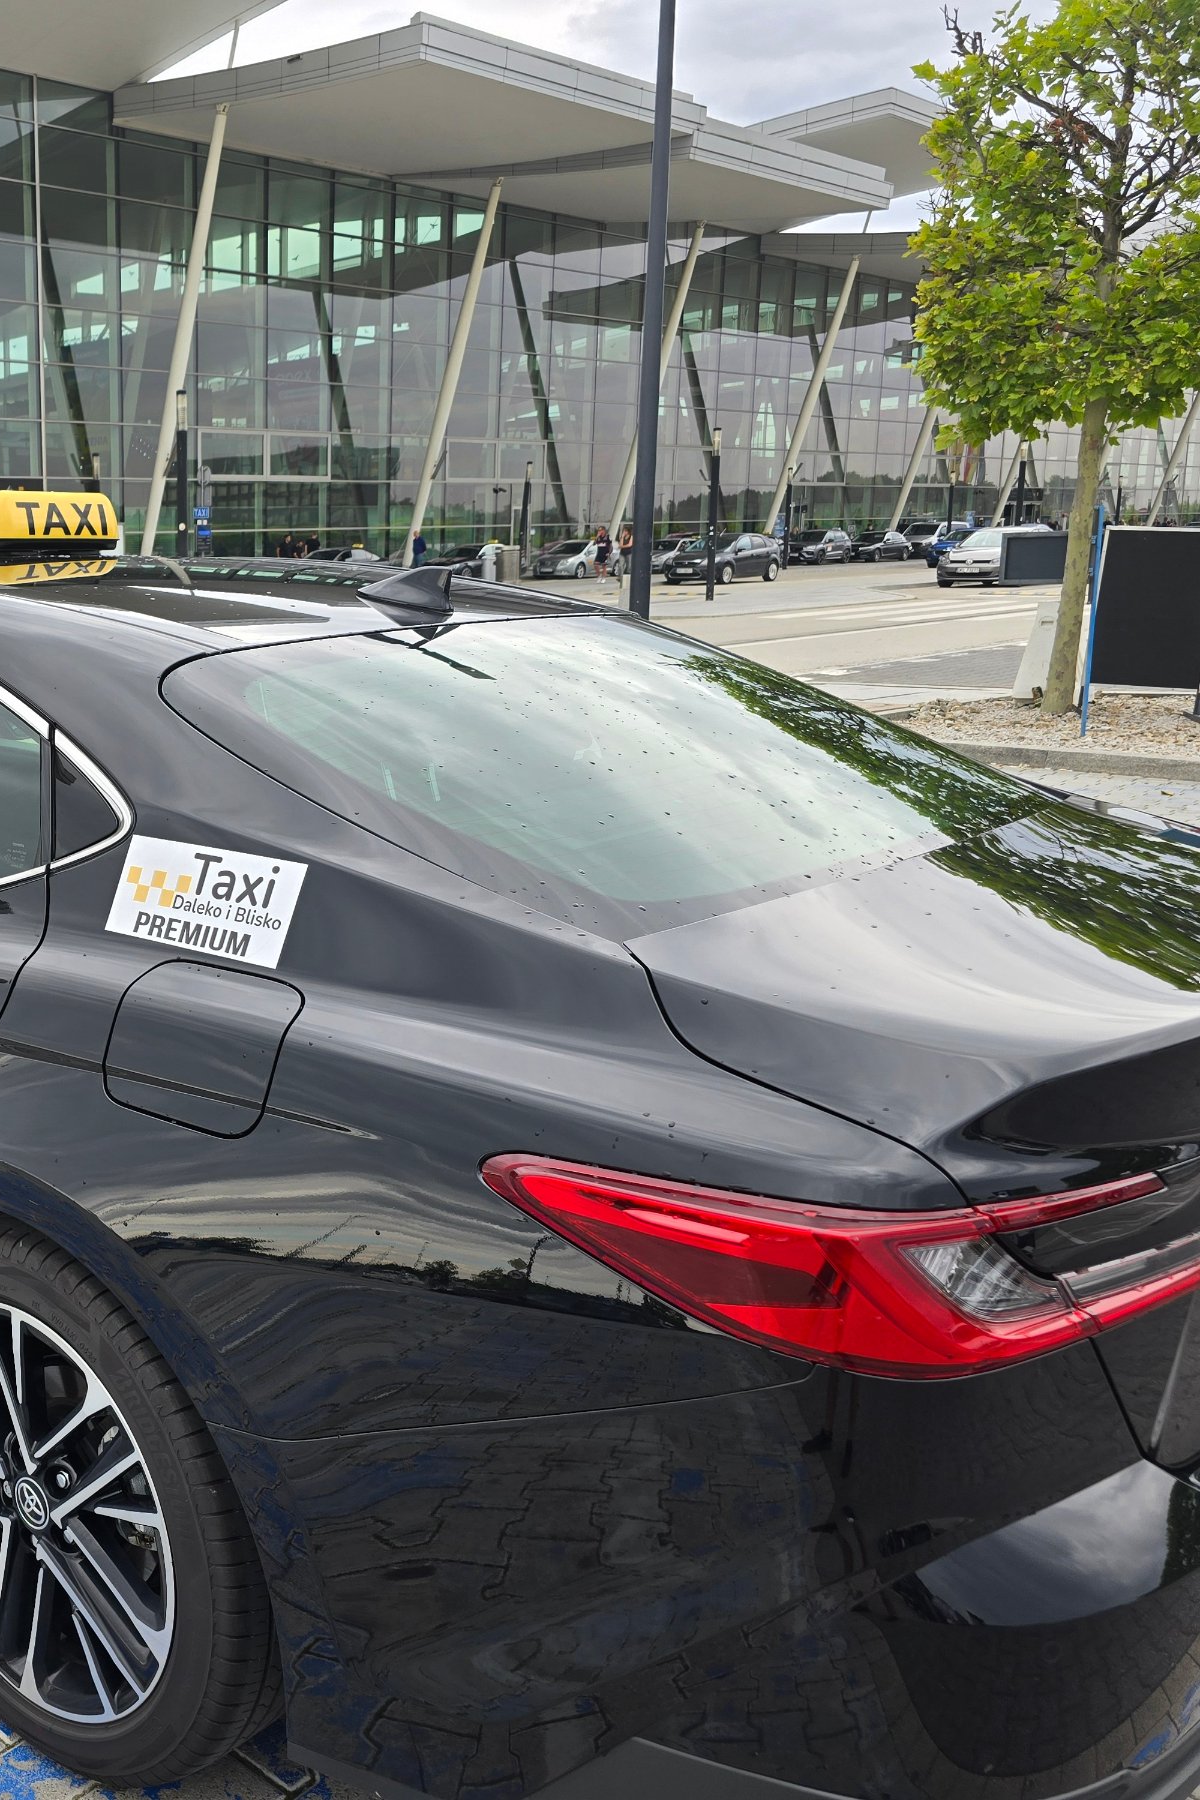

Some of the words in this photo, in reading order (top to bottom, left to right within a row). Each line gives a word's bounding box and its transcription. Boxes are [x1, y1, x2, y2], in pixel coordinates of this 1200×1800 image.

[15, 502, 109, 535] TAXI
[194, 508, 208, 517] TAXI
[194, 852, 281, 909] Taxi
[172, 894, 222, 918] Daleko
[225, 904, 232, 920] i
[234, 907, 282, 931] Blisko
[133, 911, 252, 957] PREMIUM
